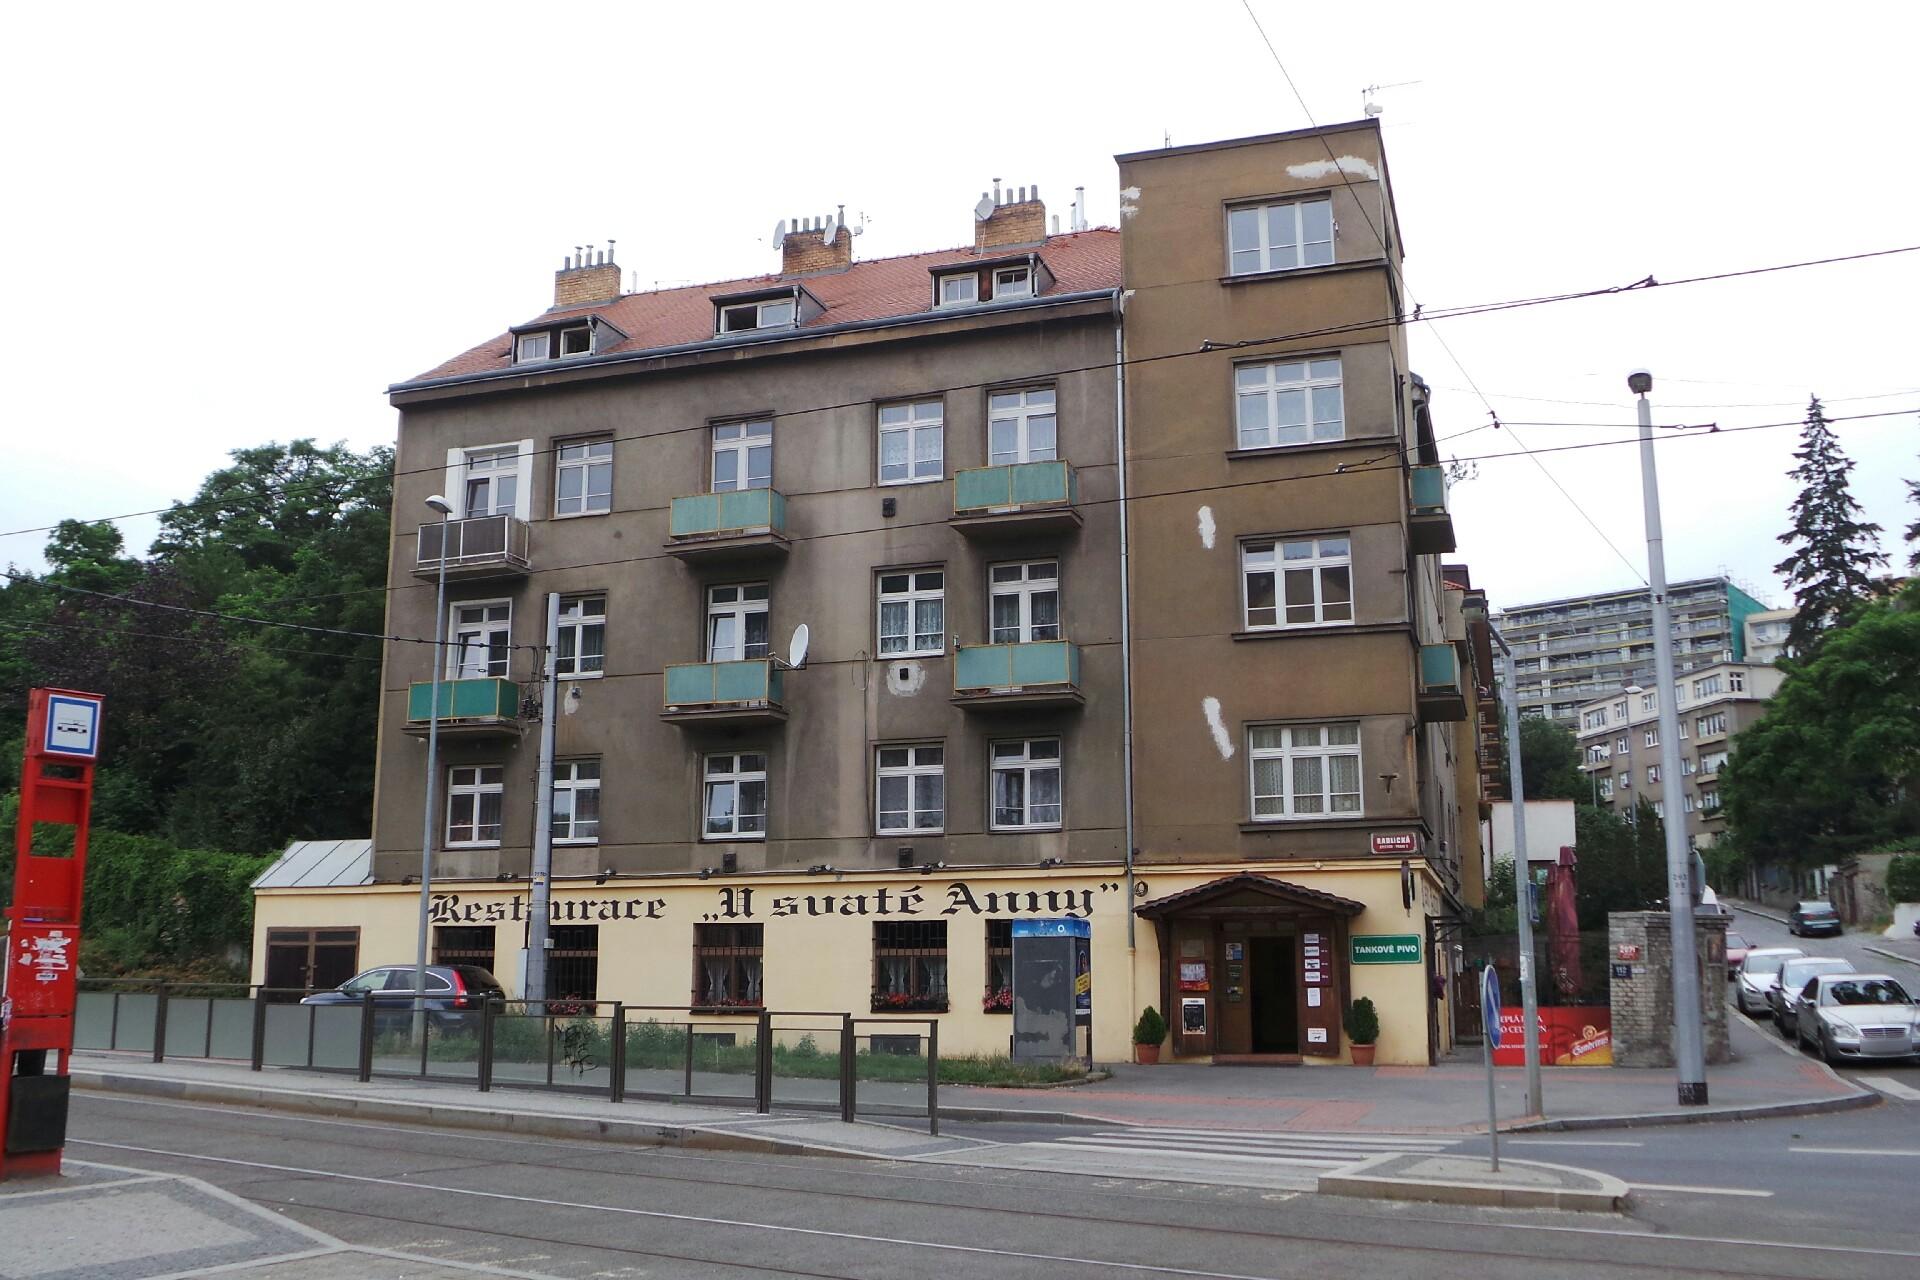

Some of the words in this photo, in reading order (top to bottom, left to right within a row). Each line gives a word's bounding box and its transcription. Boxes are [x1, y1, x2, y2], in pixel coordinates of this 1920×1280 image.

[1376, 835, 1411, 845] RADLICKÁ
[428, 894, 667, 924] Resturace
[1354, 944, 1395, 954] TANKOVÉ
[1396, 944, 1417, 953] PIVO
